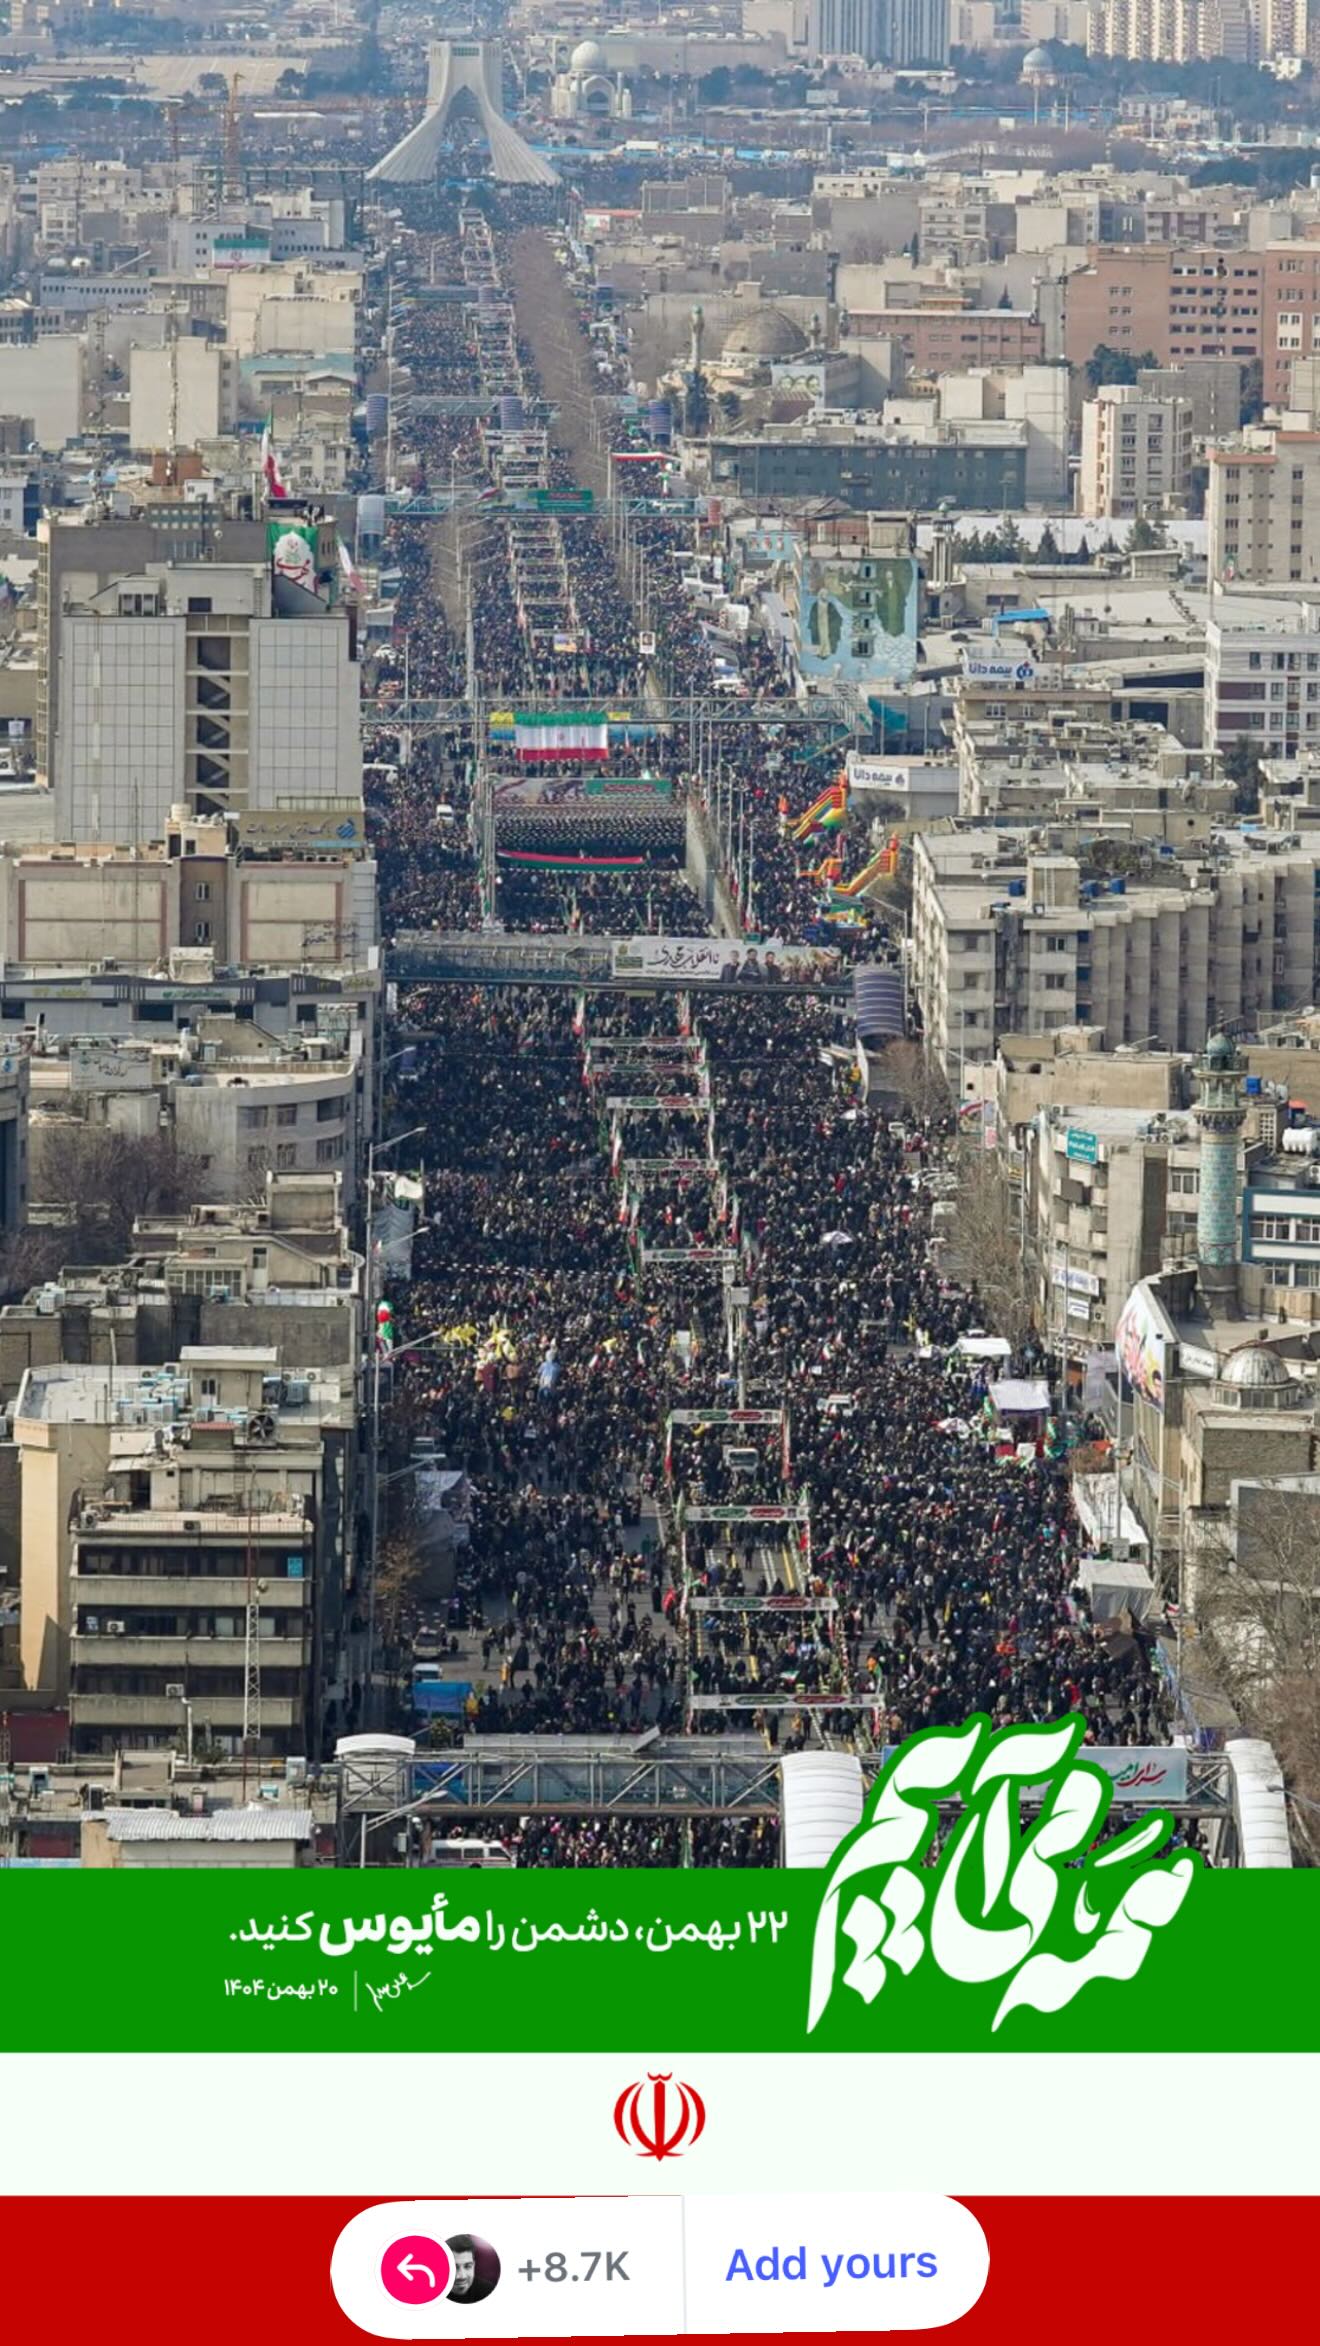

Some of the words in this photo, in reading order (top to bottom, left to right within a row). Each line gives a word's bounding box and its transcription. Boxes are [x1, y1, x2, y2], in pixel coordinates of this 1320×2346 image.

[968, 661, 988, 675] دانا
[989, 664, 1013, 678] بیمه
[853, 767, 871, 781] دانا
